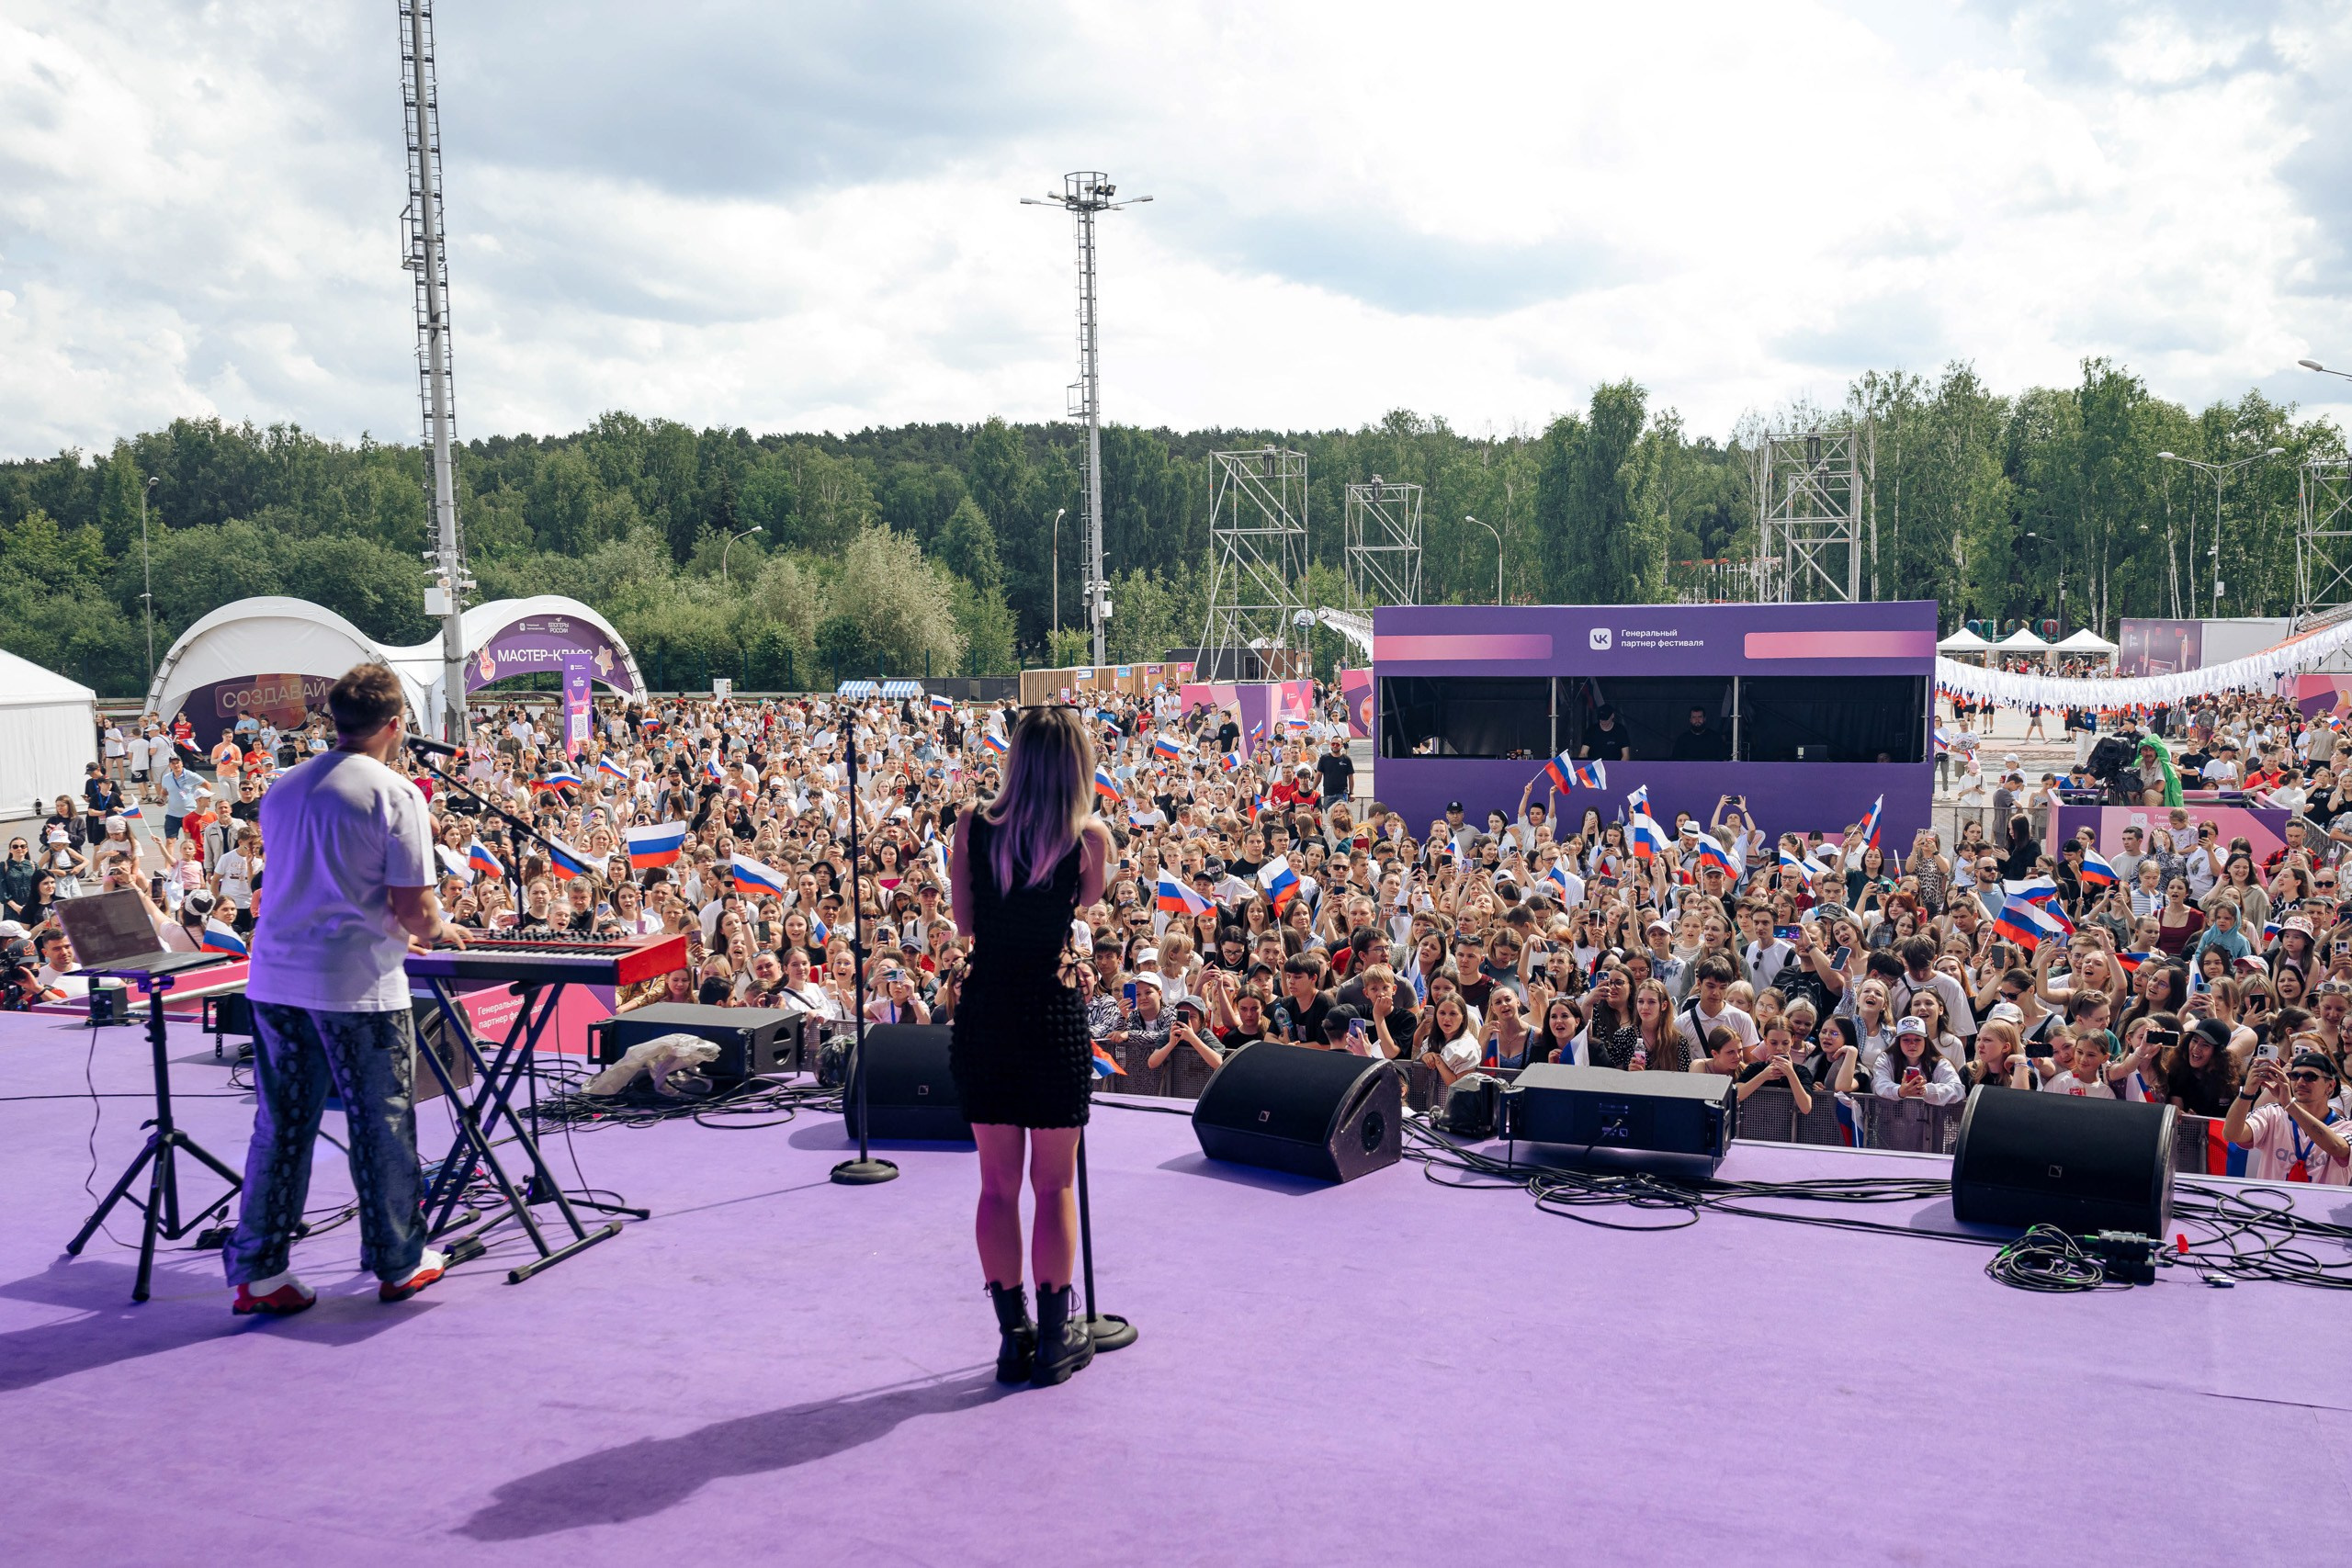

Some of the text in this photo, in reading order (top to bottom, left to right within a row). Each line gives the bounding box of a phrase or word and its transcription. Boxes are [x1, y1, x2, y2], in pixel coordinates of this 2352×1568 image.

[1657, 639, 1704, 648] фестиваля
[222, 678, 326, 708] СОЗДАВАЙ
[478, 995, 525, 1016] Генеральный
[479, 1014, 508, 1029] партнер
